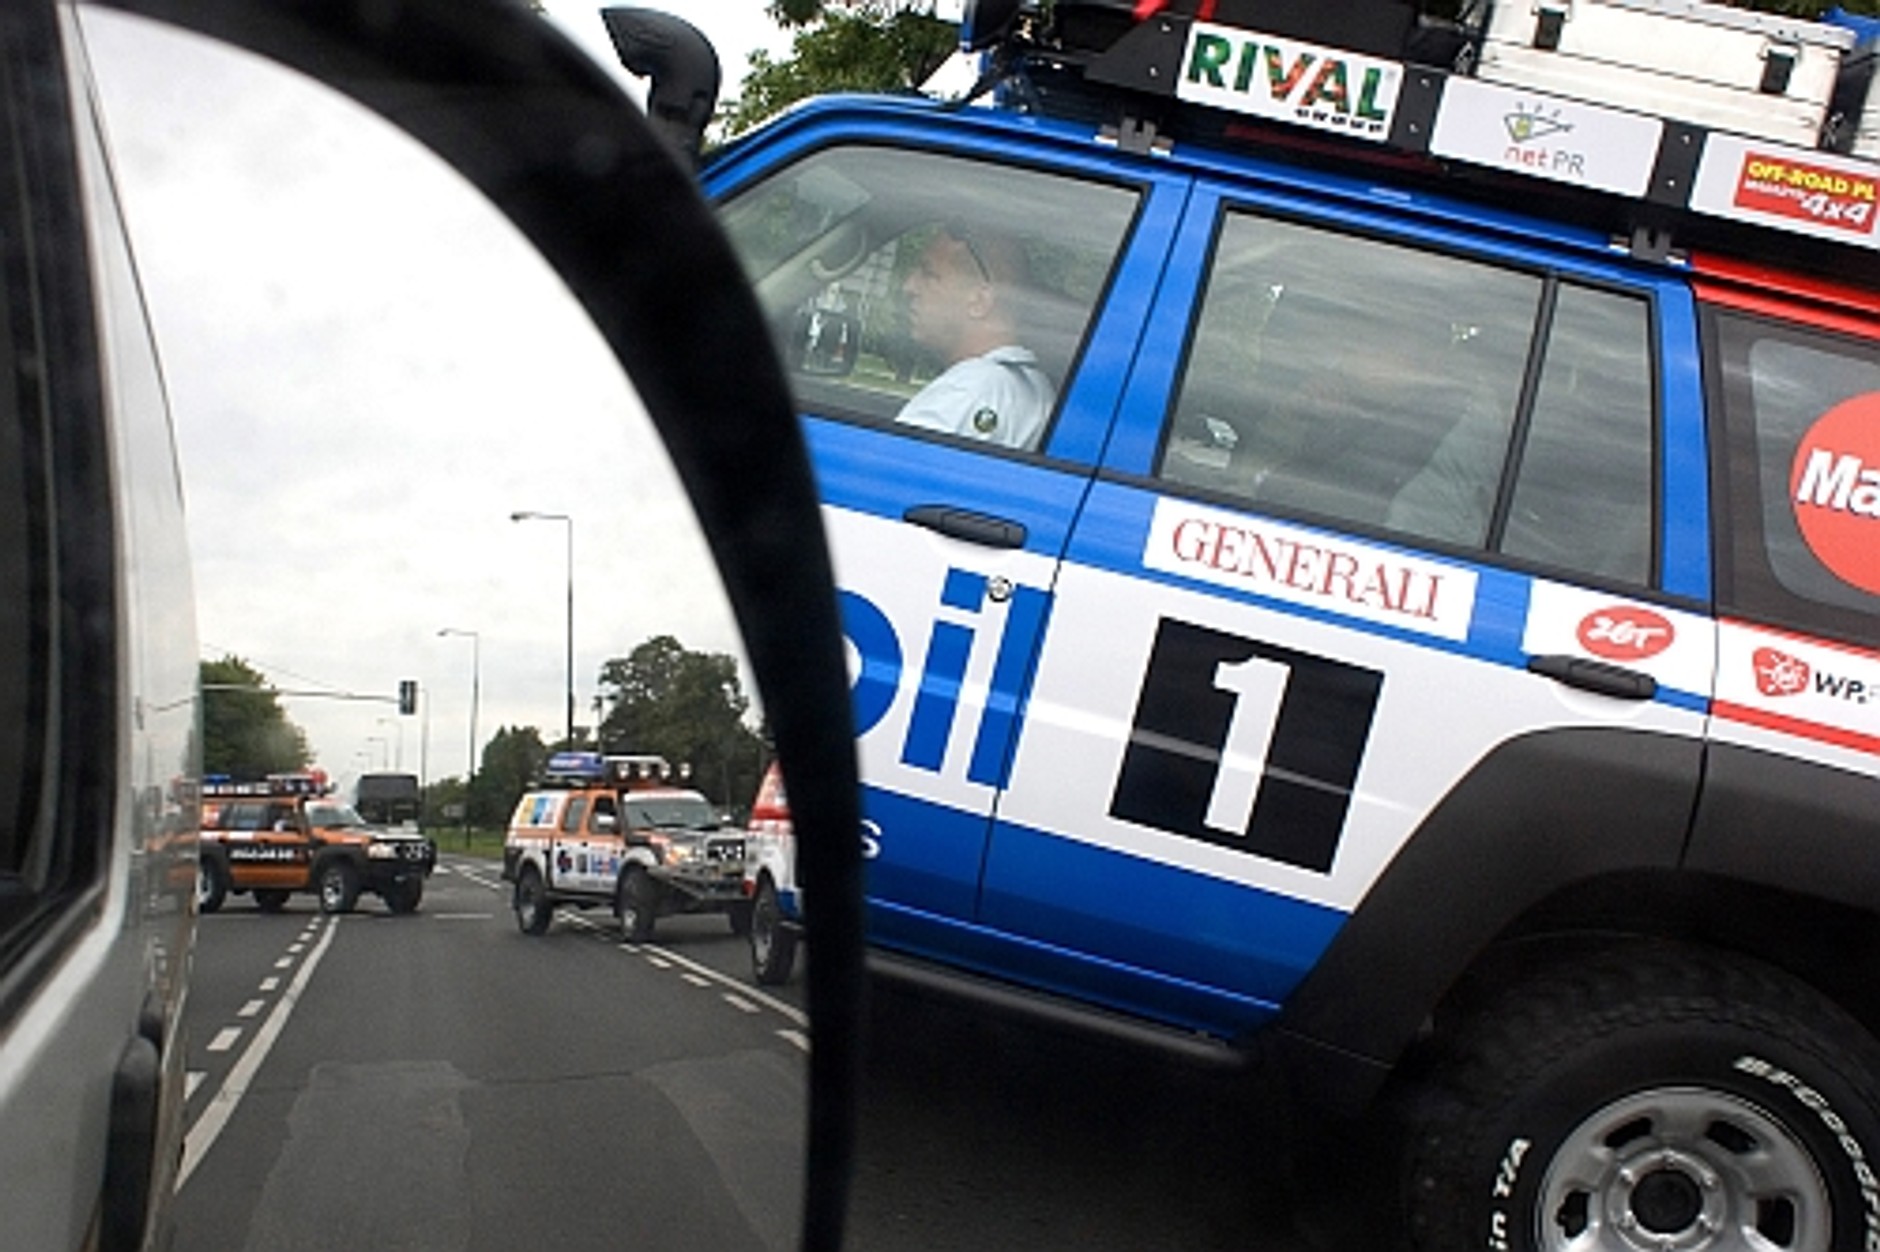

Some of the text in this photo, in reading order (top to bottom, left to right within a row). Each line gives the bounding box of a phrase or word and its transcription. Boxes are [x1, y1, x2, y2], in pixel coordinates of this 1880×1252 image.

[1187, 31, 1387, 121] RIVAL
[1799, 193, 1873, 224] 4x4
[1172, 517, 1444, 621] GENERALI
[1213, 654, 1292, 837] 1
